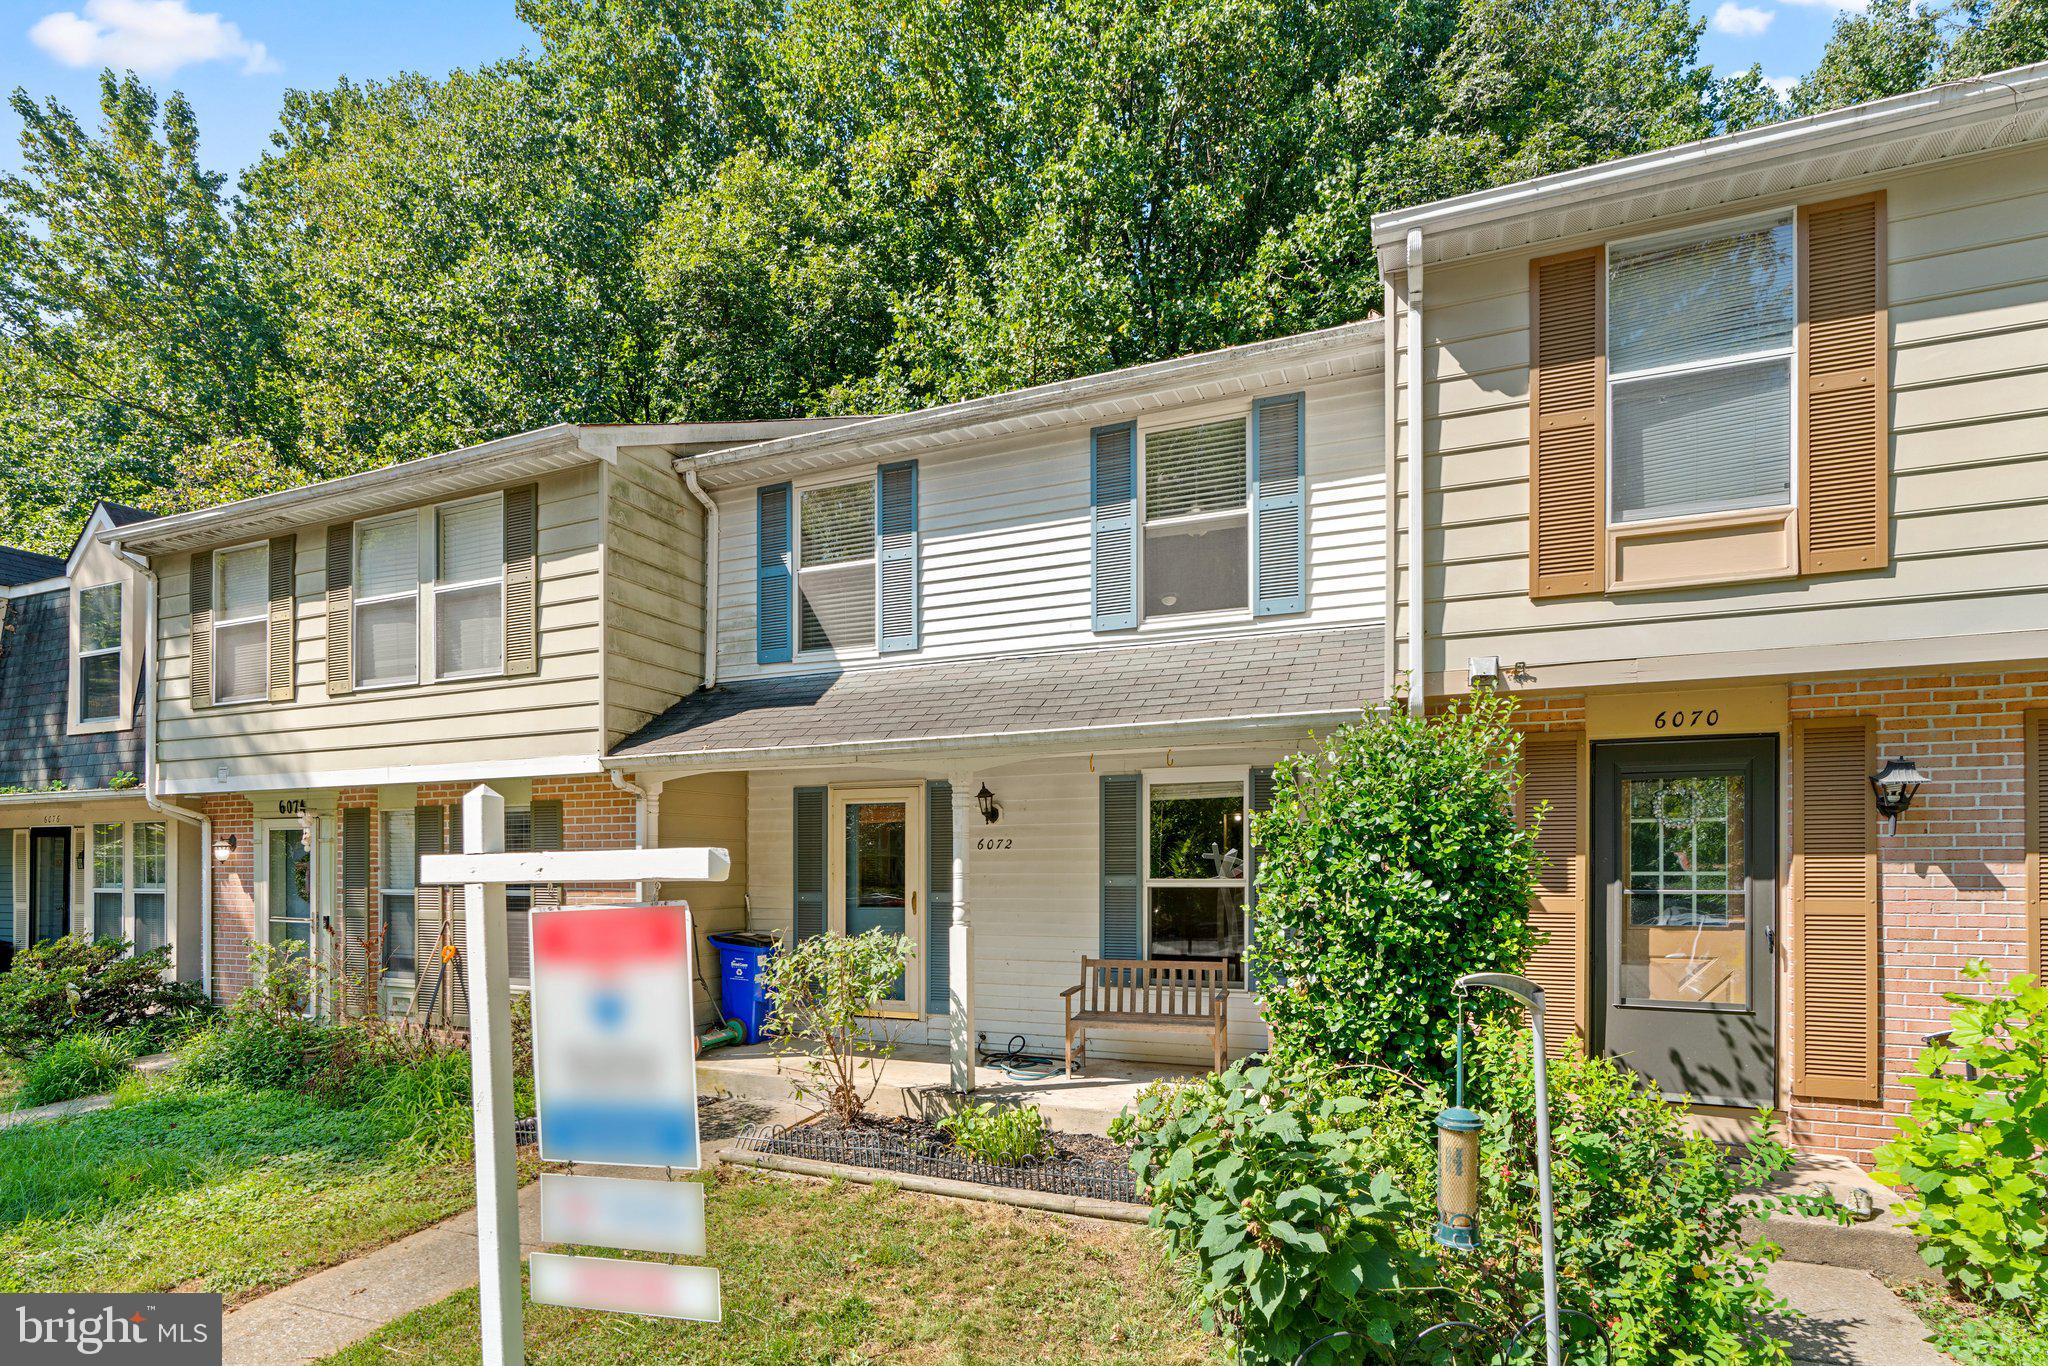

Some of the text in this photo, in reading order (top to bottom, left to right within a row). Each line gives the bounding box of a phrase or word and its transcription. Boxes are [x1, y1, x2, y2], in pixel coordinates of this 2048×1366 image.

[1655, 709, 1719, 729] 6070
[279, 799, 306, 814] 6074
[977, 838, 1012, 850] 6072
